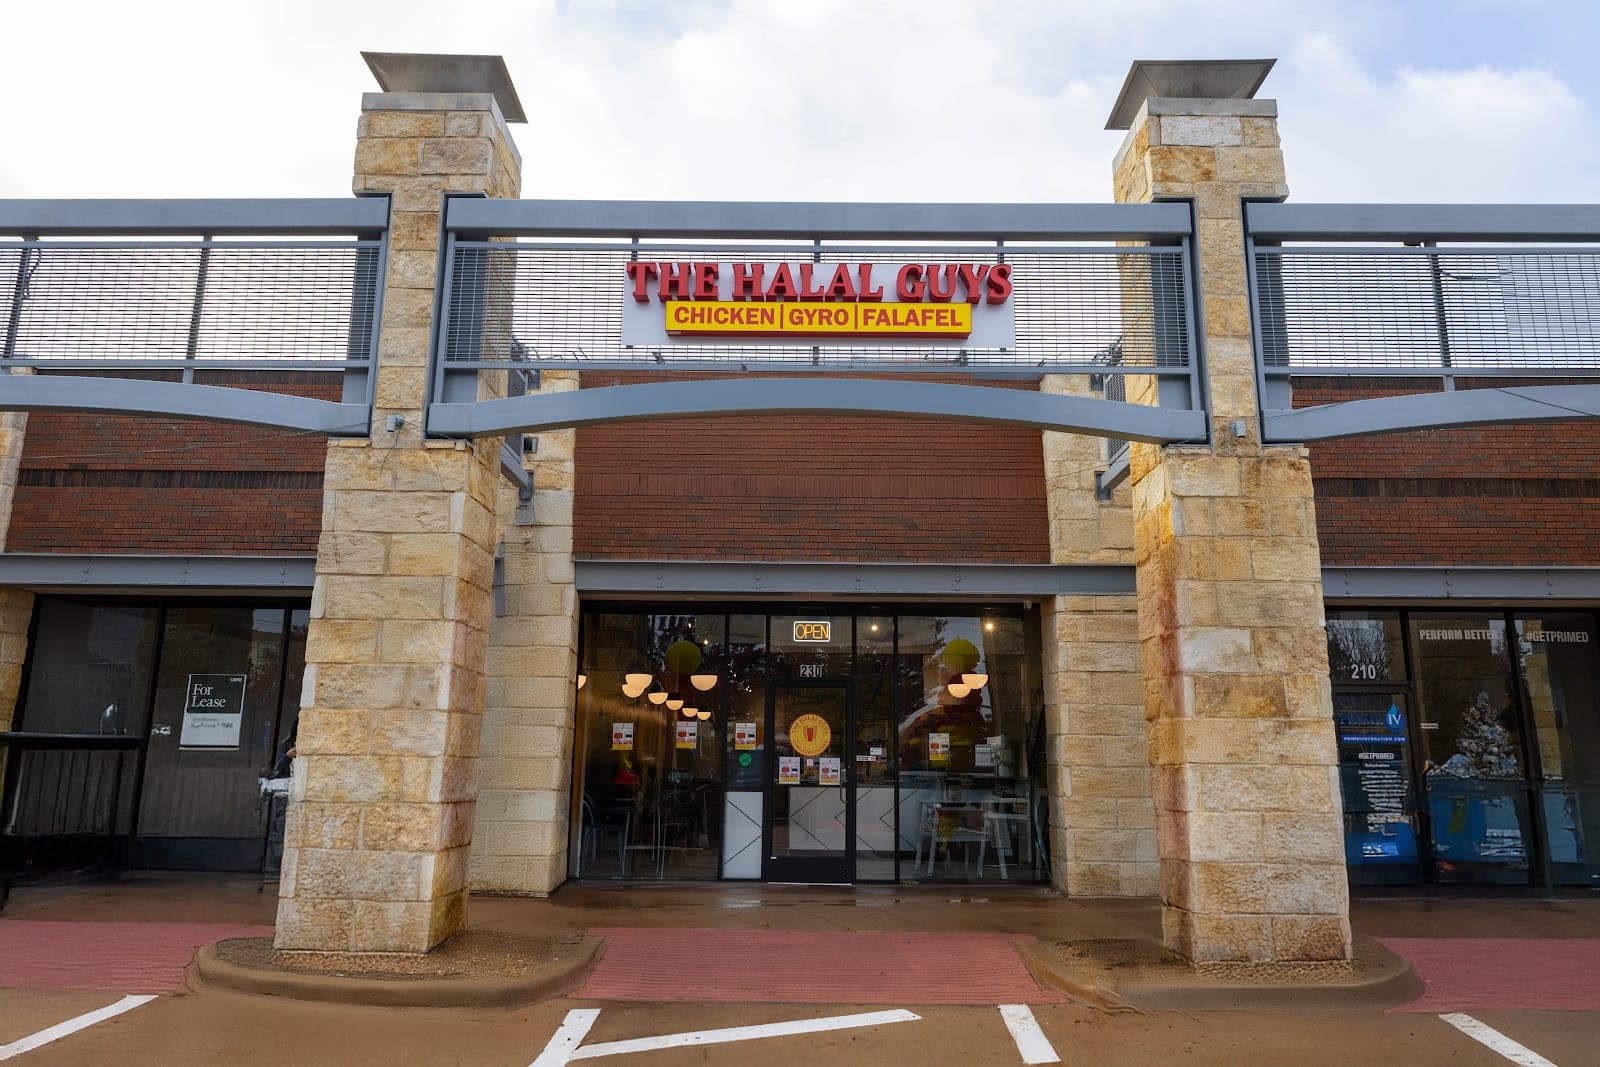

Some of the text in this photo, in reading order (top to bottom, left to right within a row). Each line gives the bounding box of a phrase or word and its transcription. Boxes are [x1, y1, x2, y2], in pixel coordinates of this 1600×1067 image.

[626, 262, 1012, 305] THE HALAL GUYS
[674, 306, 962, 327] CHICKEN GYRO FALAFEL
[796, 624, 829, 639] OPEN
[1419, 630, 1463, 640] PERFORM
[1526, 631, 1589, 643] #GETPRIMED
[801, 665, 821, 677] 230
[1351, 664, 1376, 679] 210
[192, 683, 213, 696] For
[191, 696, 226, 708] Lease
[1388, 714, 1402, 725] IV
